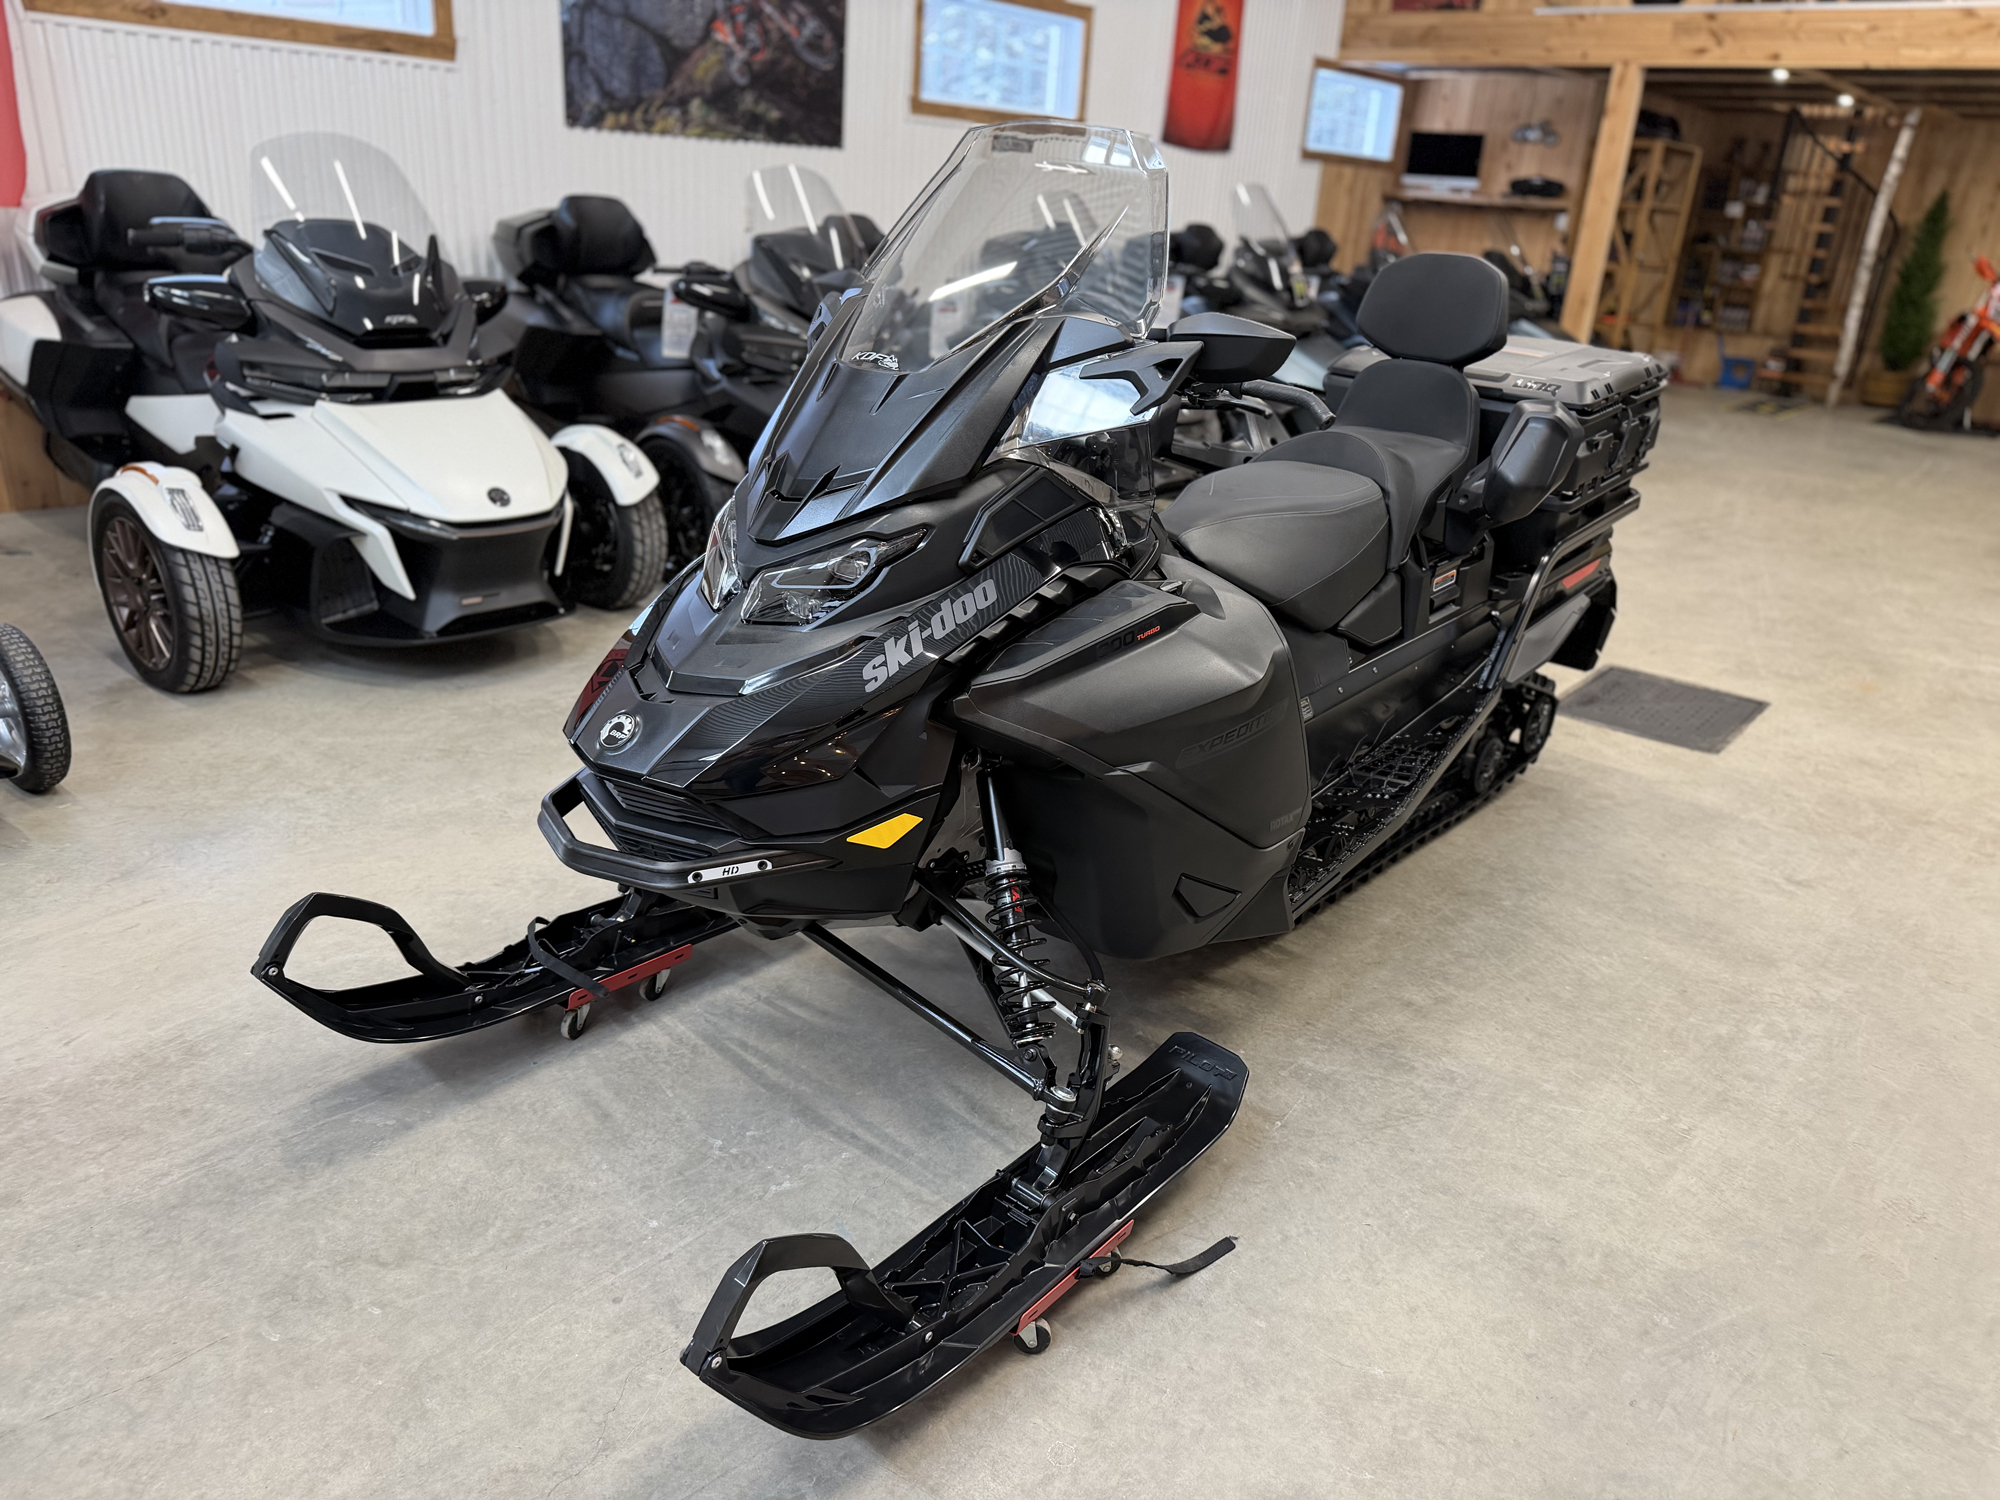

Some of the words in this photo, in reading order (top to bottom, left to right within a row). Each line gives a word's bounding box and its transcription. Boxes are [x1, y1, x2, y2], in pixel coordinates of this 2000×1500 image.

[1136, 625, 1161, 641] TURBO
[610, 729, 628, 740] BRP
[1180, 704, 1283, 759] EXPEDITI
[722, 866, 740, 876] HD
